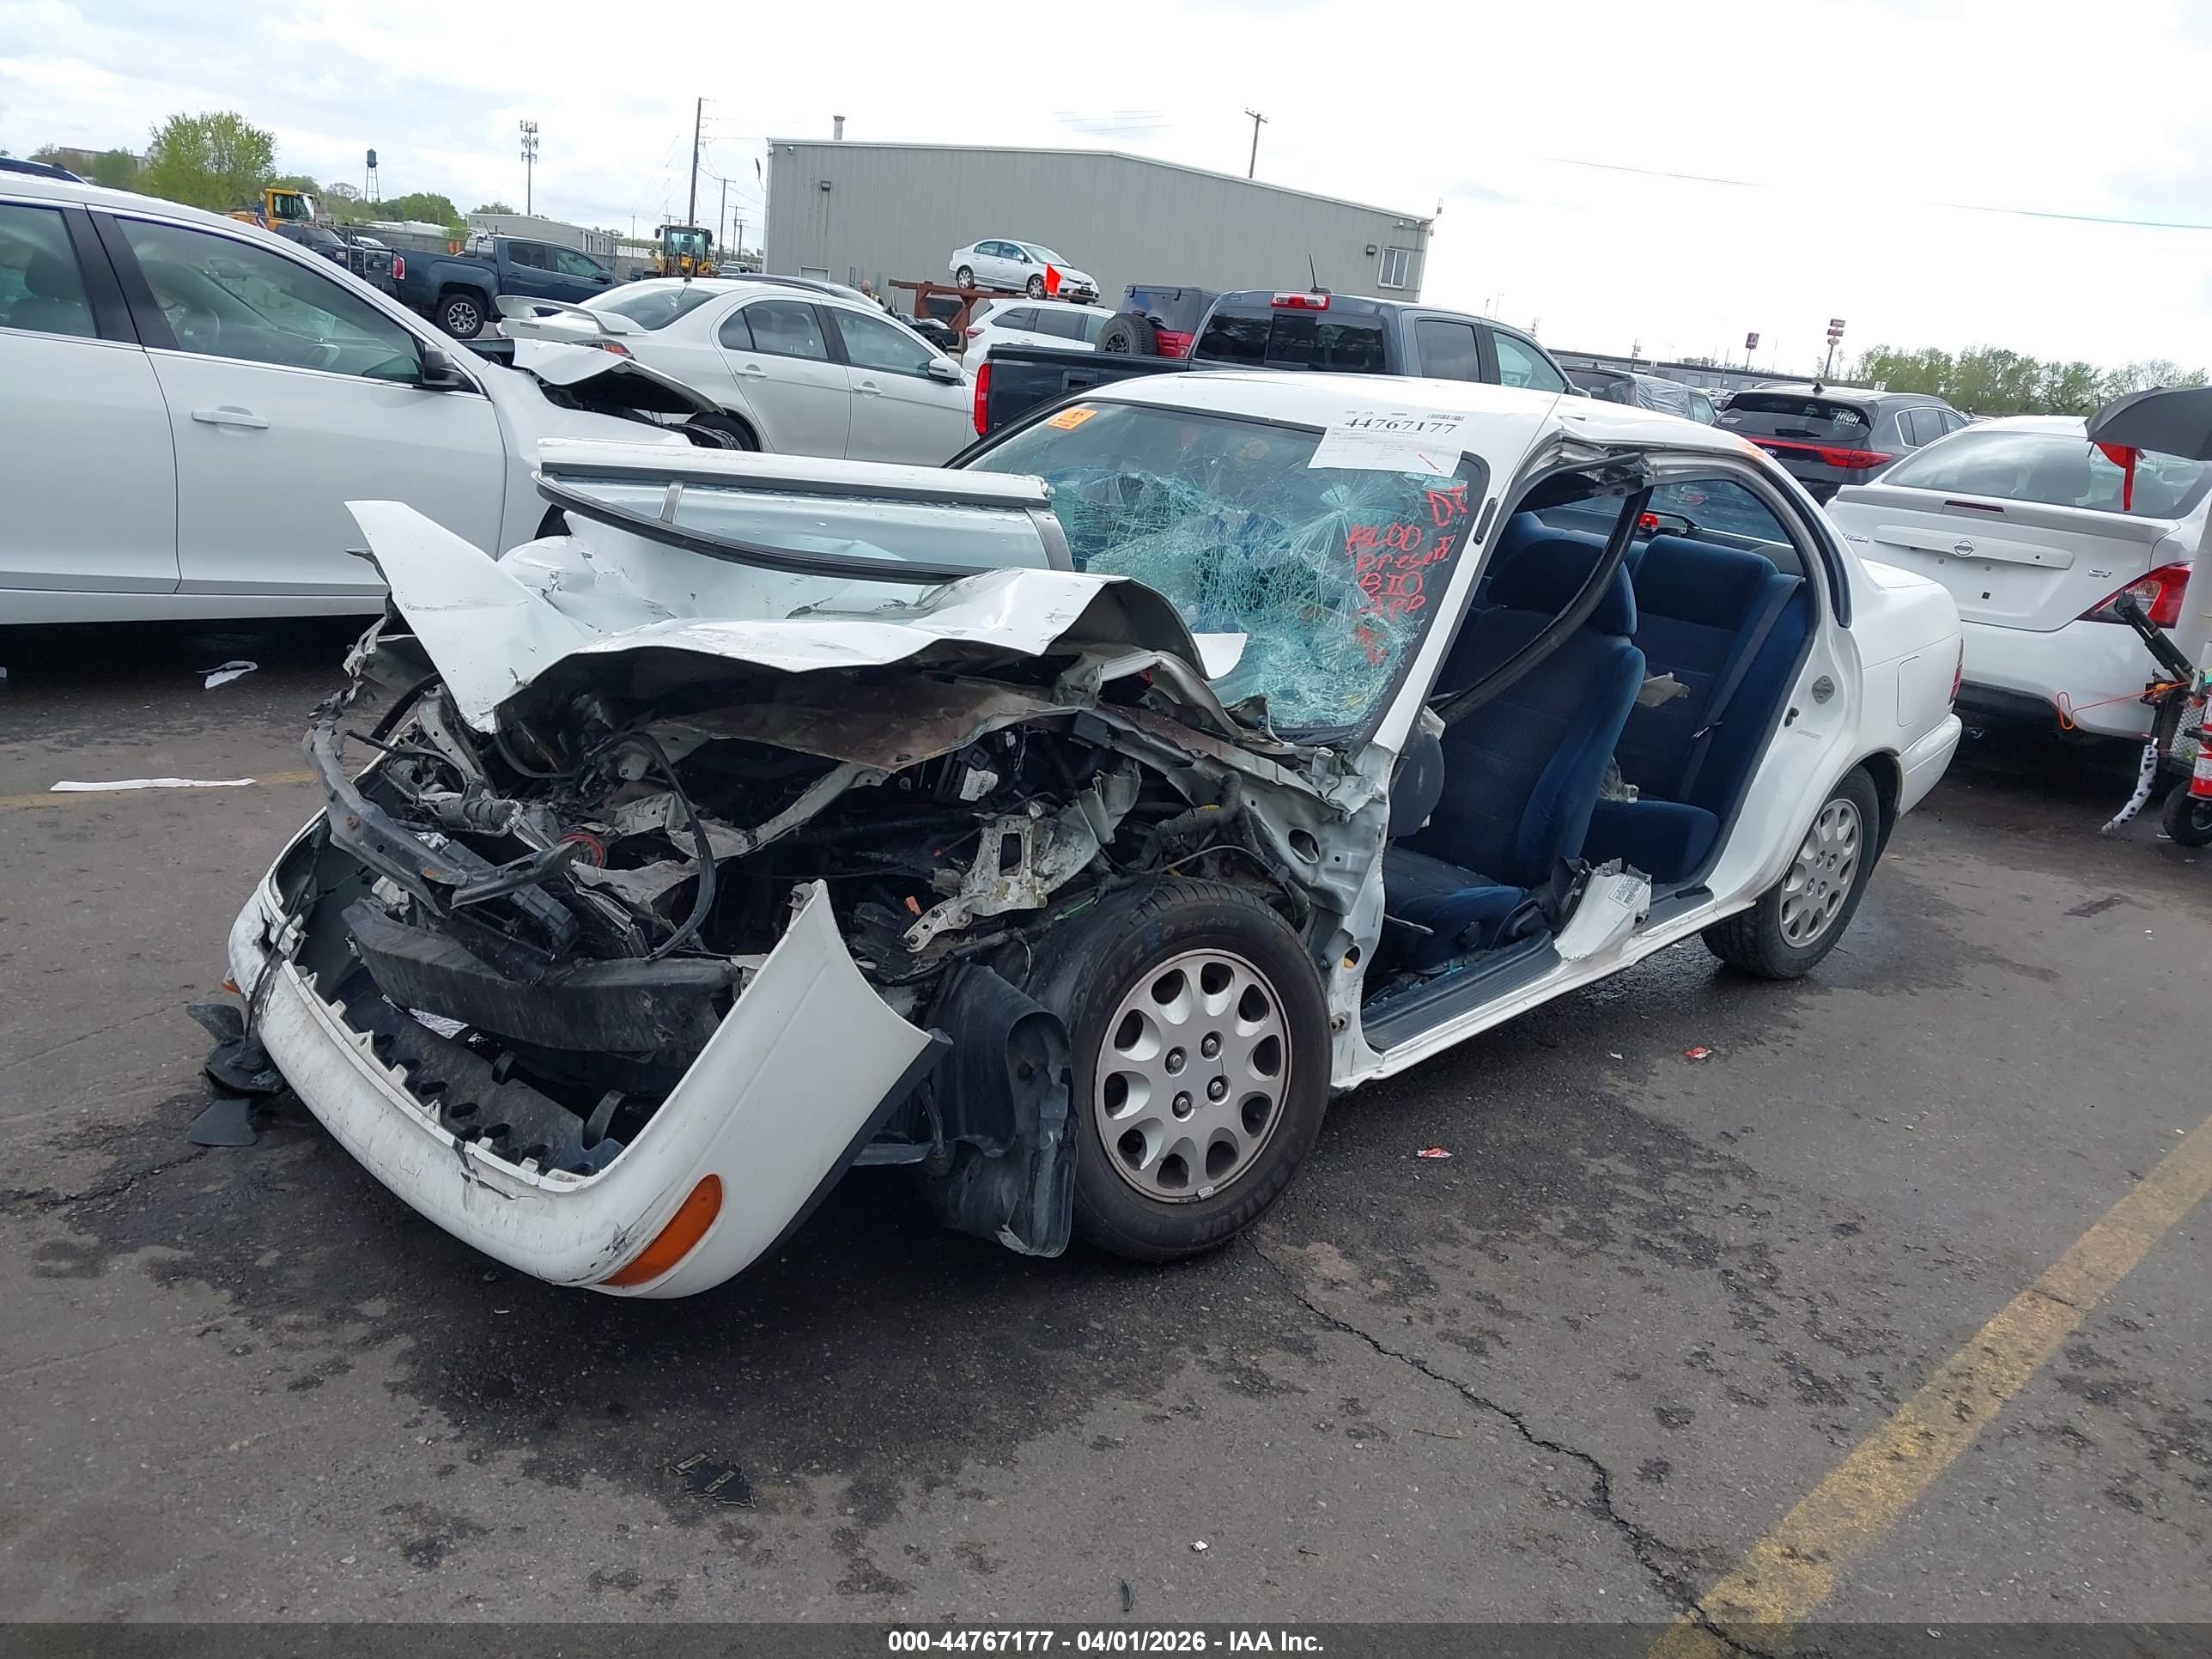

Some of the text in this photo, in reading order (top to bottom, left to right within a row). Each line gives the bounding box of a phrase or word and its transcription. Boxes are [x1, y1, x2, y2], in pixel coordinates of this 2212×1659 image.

[1835, 411, 1861, 424] HIGH
[1345, 417, 1457, 434] 44767177
[2087, 569, 2112, 578] SV
